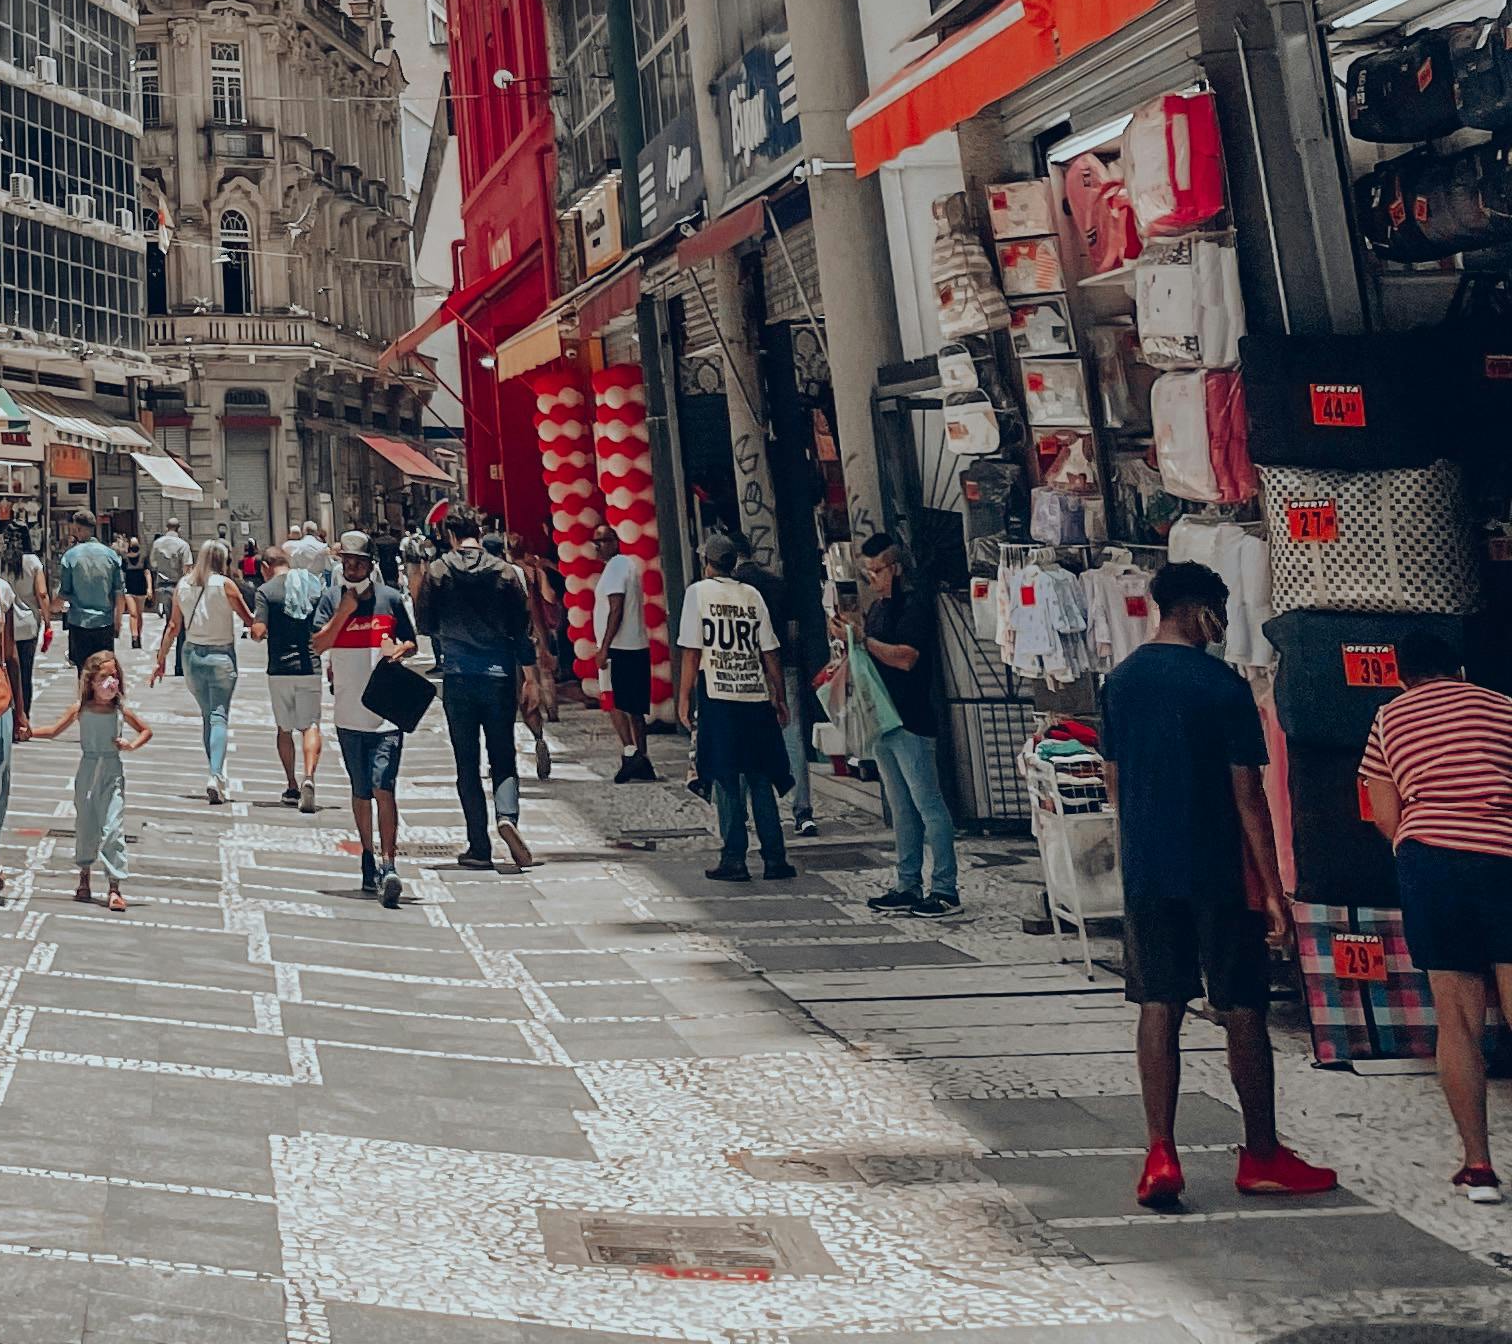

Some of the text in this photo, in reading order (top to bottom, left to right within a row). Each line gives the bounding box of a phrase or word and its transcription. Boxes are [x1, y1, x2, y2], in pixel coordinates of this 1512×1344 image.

[1315, 385, 1359, 393] OFERTA
[1290, 500, 1330, 509] OFERTA
[1346, 645, 1389, 653] OFERTA
[1335, 934, 1379, 943] OFERTA
